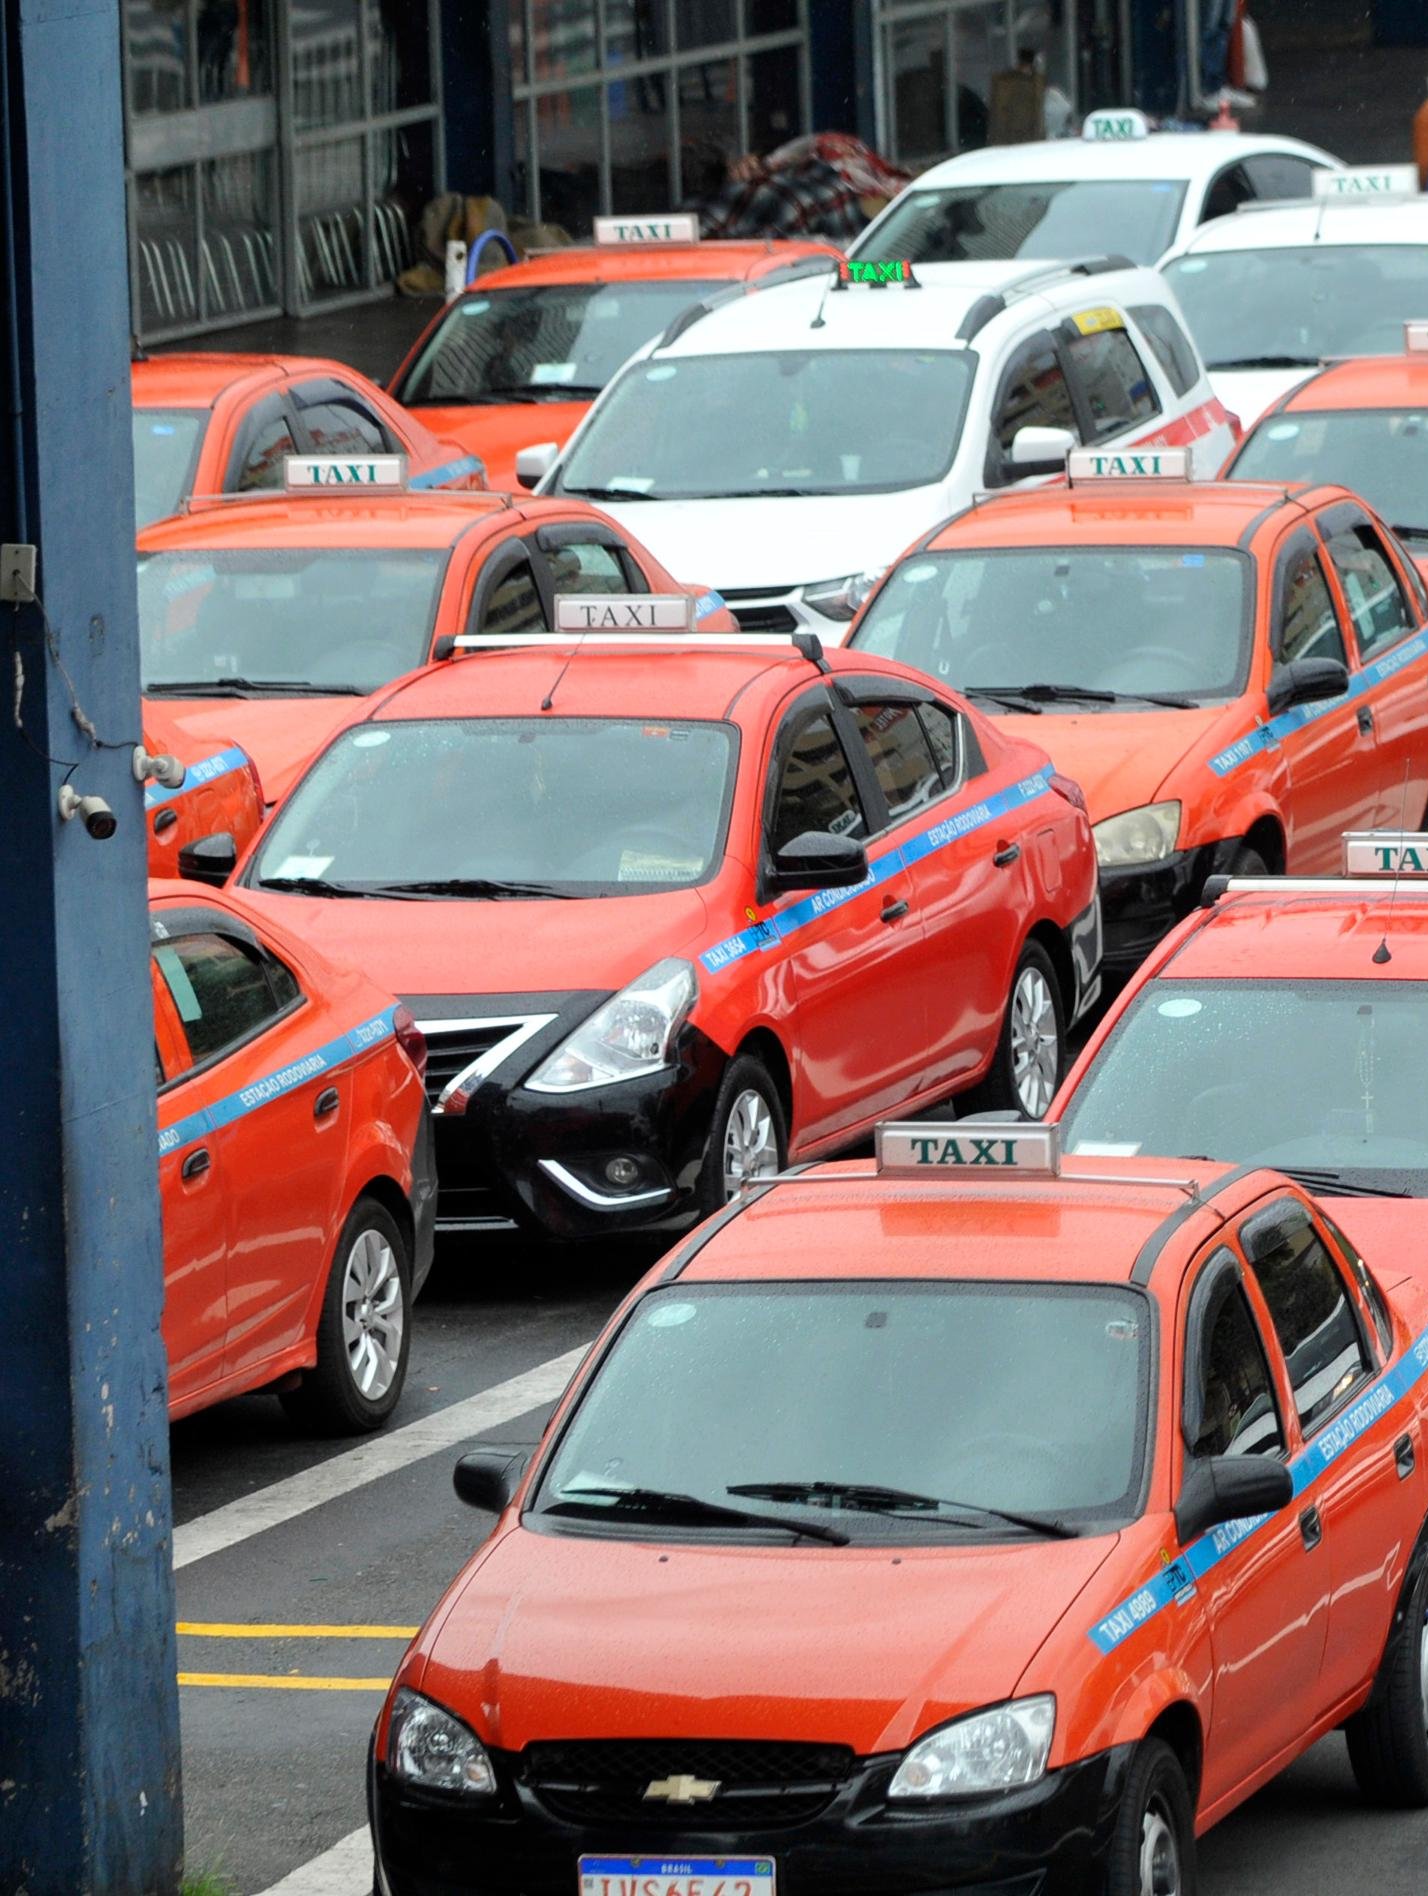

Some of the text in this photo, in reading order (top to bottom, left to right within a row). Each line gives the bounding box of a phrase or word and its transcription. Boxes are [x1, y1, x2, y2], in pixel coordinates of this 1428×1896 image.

[1093, 119, 1133, 137] TAXI
[1334, 176, 1391, 193] TAXI
[614, 225, 671, 241] TAXI
[848, 262, 903, 281] TAXI
[307, 465, 377, 485] TAXI
[1090, 457, 1161, 475] TAXI
[581, 605, 656, 626] TAXI
[811, 895, 826, 914] AR
[706, 945, 729, 968] TAXI
[239, 1054, 327, 1107] ESTAÇÃO RODOVIÁRIA
[911, 1139, 1018, 1165] TAXI
[1318, 1384, 1395, 1461] ESTAÇÃO RODOVIÁRIA
[1211, 1526, 1231, 1555] AR
[1099, 1611, 1134, 1643] TAXI
[661, 1863, 692, 1874] BRASIL
